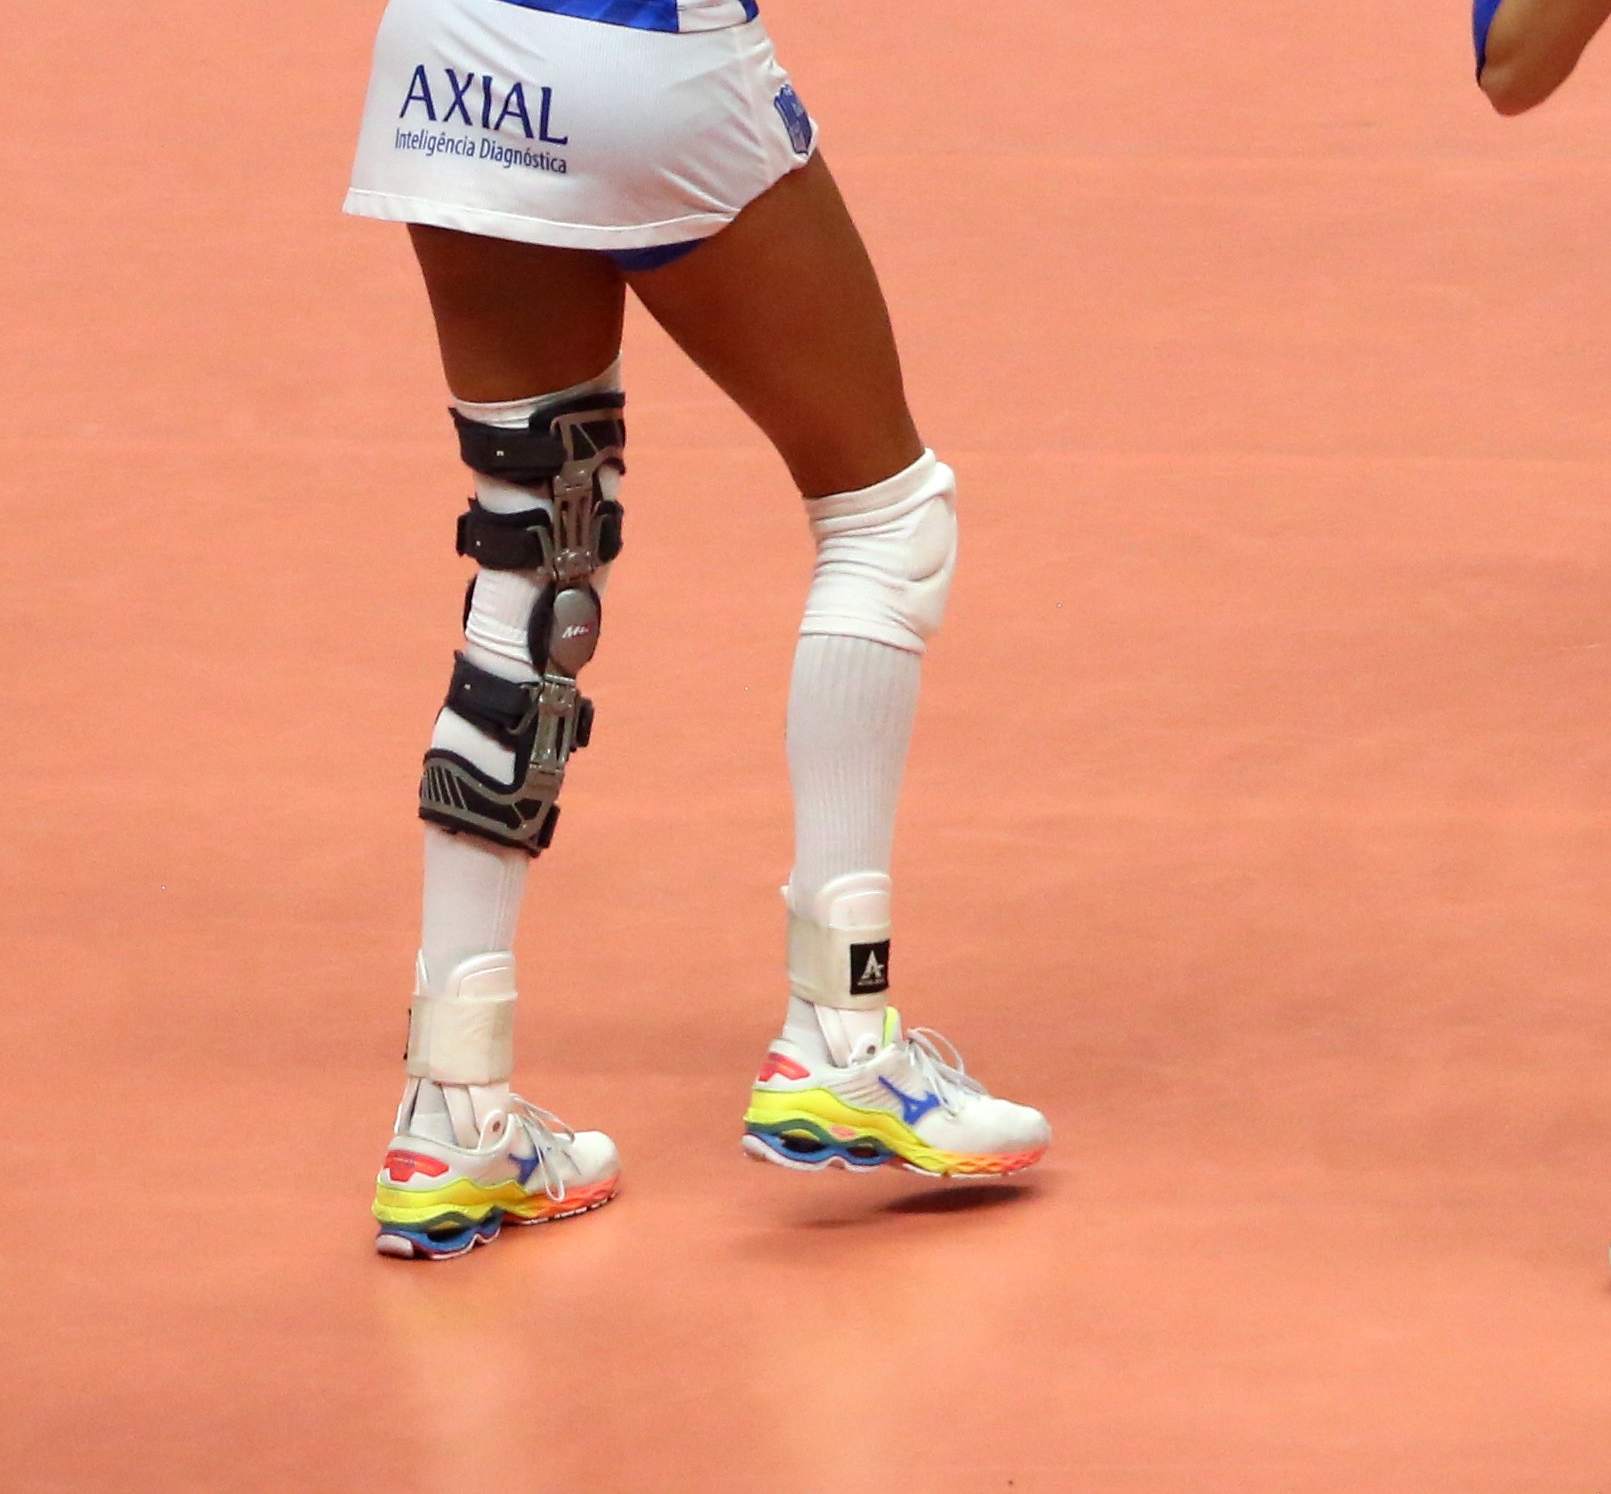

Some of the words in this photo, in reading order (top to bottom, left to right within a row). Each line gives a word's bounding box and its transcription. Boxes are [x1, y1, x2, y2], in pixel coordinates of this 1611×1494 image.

[400, 64, 569, 147] AXIAL
[394, 128, 476, 158] Inteligência
[479, 138, 568, 175] Diagnóstica
